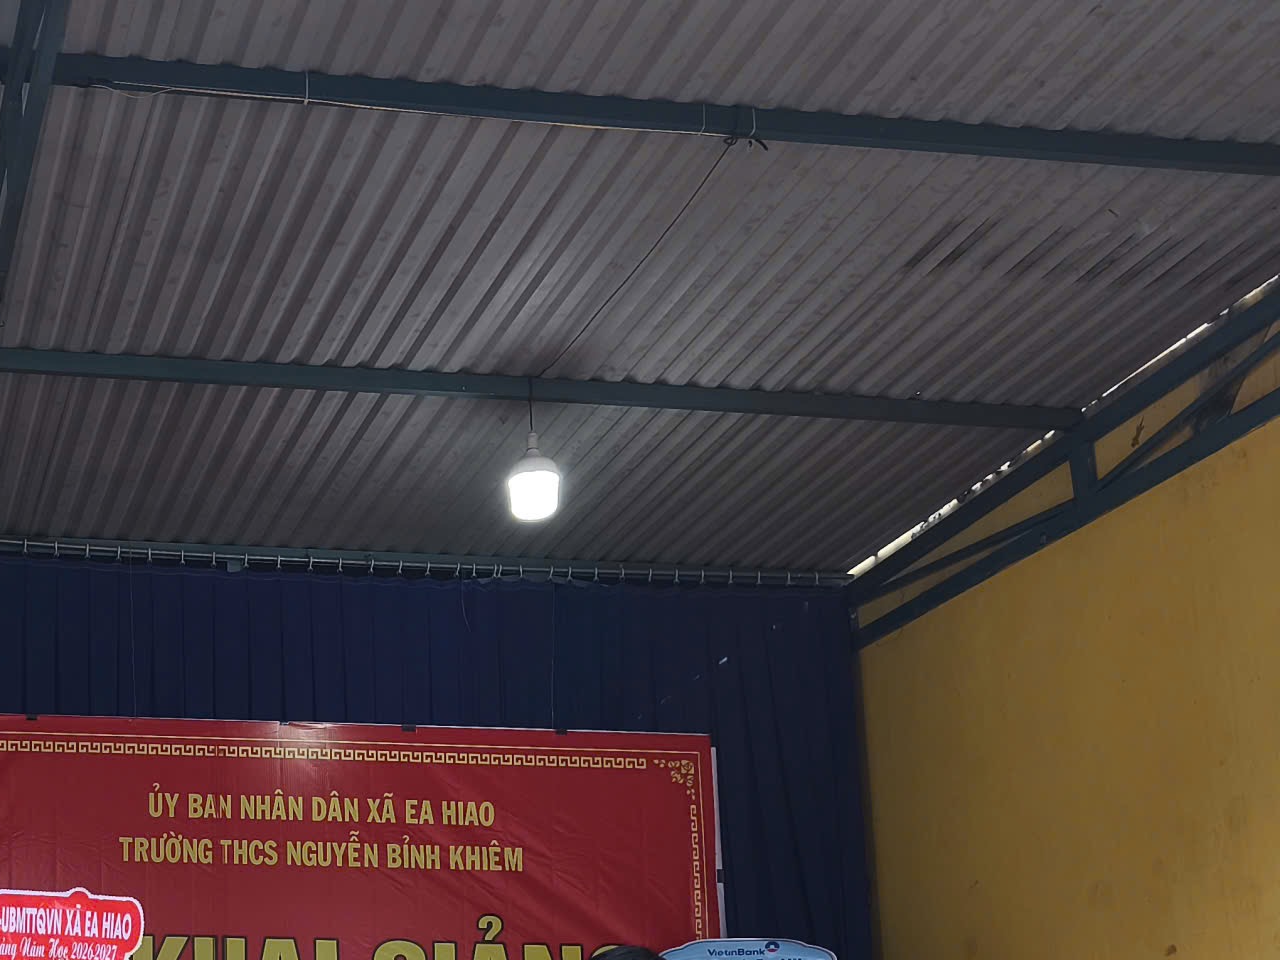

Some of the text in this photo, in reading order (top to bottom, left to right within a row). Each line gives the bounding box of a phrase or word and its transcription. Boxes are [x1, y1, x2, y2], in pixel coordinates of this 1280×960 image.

[148, 783, 496, 827] ỦY BAN NHÂN DÂN XÃ EA HIAO
[118, 830, 524, 872] TRƯỜNG THCS NGUYỄN BỈNH KHIÊM
[64, 904, 82, 936] XÃ
[84, 911, 99, 938] EA
[102, 912, 132, 940] HIAO
